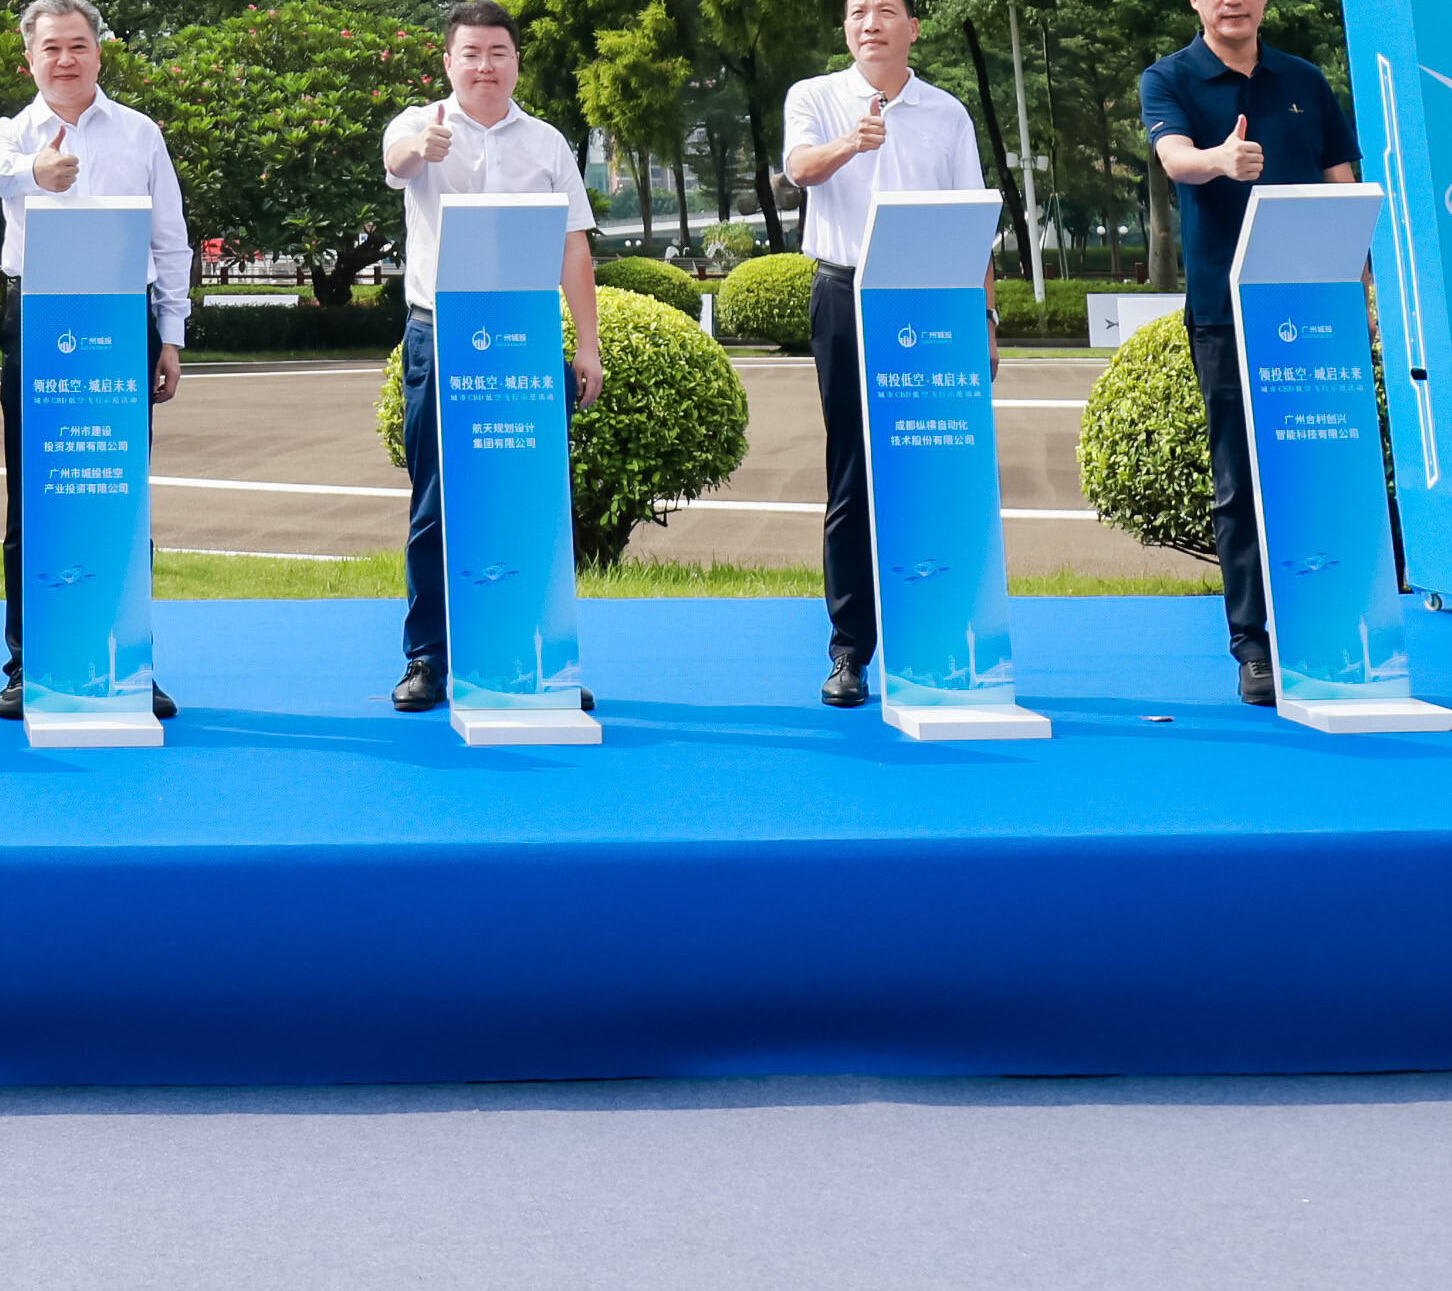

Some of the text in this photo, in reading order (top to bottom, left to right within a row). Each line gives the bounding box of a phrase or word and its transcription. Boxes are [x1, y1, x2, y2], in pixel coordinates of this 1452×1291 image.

[80, 337, 112, 345] 广州城投
[472, 423, 535, 434] 航天规划设计
[895, 419, 969, 431] 成都纵横自动化
[59, 426, 112, 437] 广州市建设
[1275, 428, 1360, 440] 智能科技有限公司
[472, 437, 536, 449] 集团有限公司
[891, 435, 975, 446] 技术股份有限公司
[44, 441, 128, 452] 投资发展有限公司
[49, 468, 124, 479] 广州市城投低空
[44, 483, 129, 494] 产业投资有限公司
